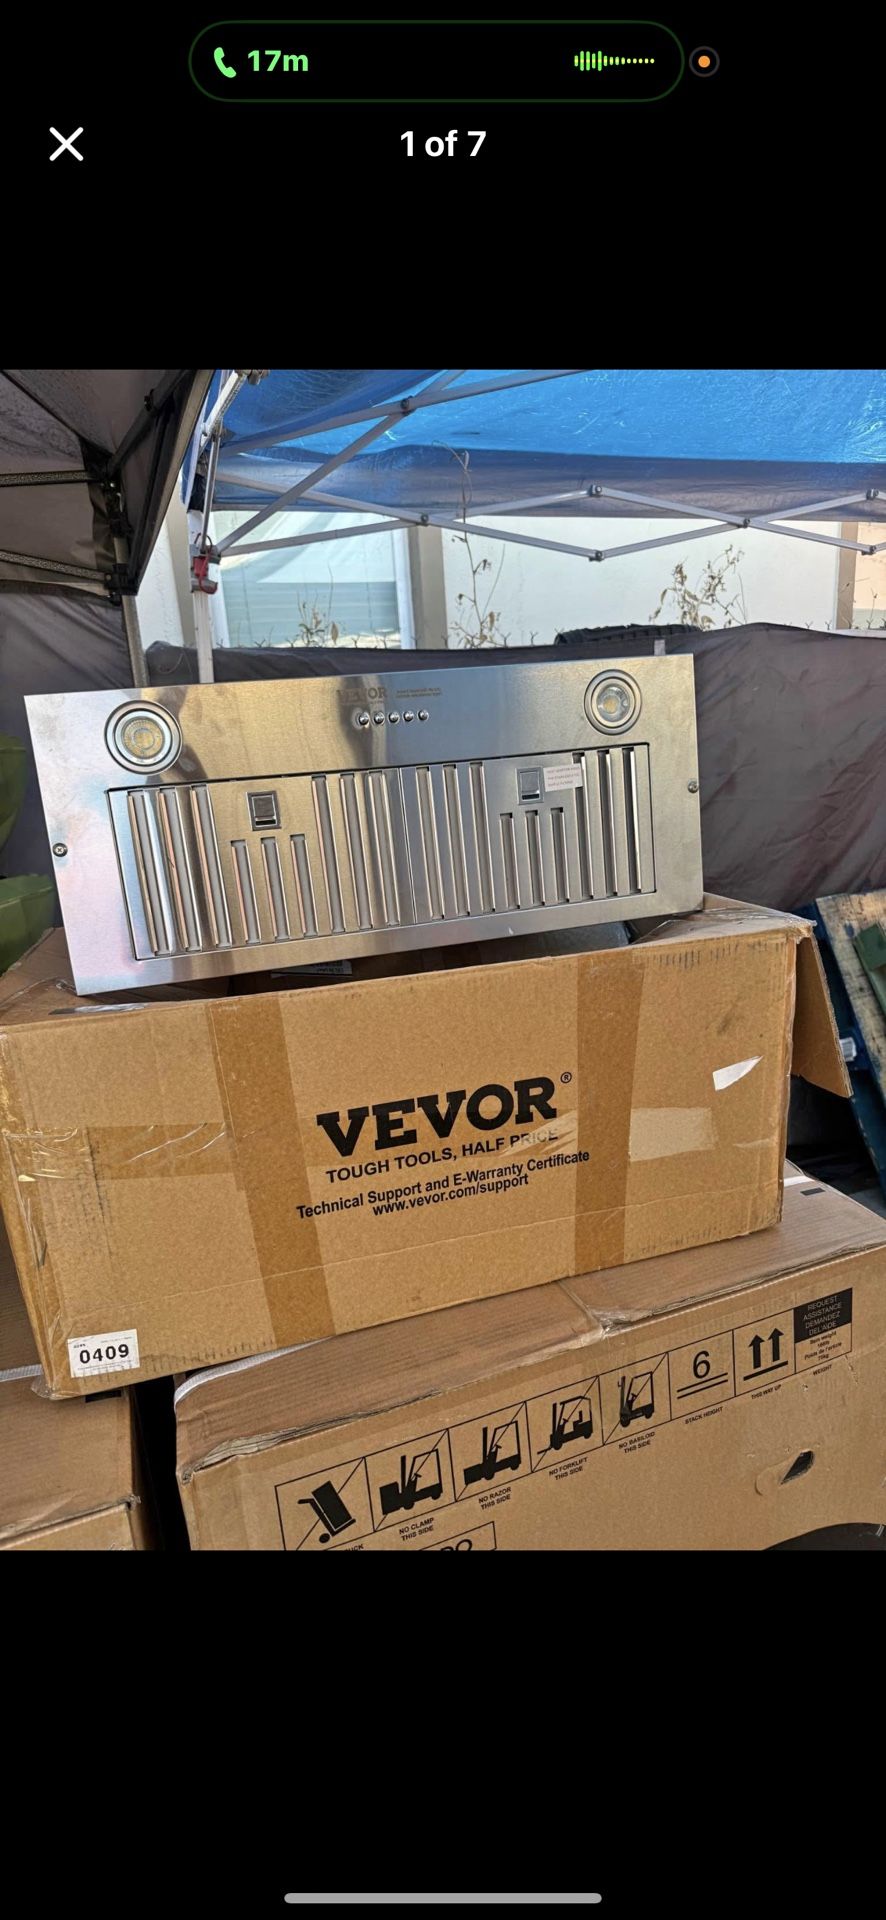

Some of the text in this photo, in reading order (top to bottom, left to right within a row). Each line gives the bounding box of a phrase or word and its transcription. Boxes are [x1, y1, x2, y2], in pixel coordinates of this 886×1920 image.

[316, 1076, 557, 1158] VEVOR
[325, 1128, 559, 1183] TOUGH TOOLS, HALF PRICE
[296, 1150, 590, 1219] Technical Support and E-Warranty Certificate
[372, 1173, 529, 1216] www.vevor.com/support
[803, 1302, 842, 1320] ASSISTANCE
[807, 1295, 838, 1311] REQUEST
[805, 1311, 841, 1329] DEMANDEZ
[79, 1343, 130, 1364] 0409
[692, 1350, 711, 1379] 6
[812, 1364, 832, 1376] WEIGHT
[763, 1387, 774, 1395] WAY
[685, 1406, 723, 1425] STACK HEIGHT
[624, 1440, 651, 1454] THIS SIDE
[549, 1457, 588, 1476] NO FORKLIFT
[555, 1466, 583, 1480] THIS SIDE
[478, 1486, 512, 1504] NO RAZOR
[480, 1494, 511, 1510] THIS SIDE
[399, 1517, 435, 1535] NO CLAMP
[401, 1525, 434, 1541] THIS SIDE
